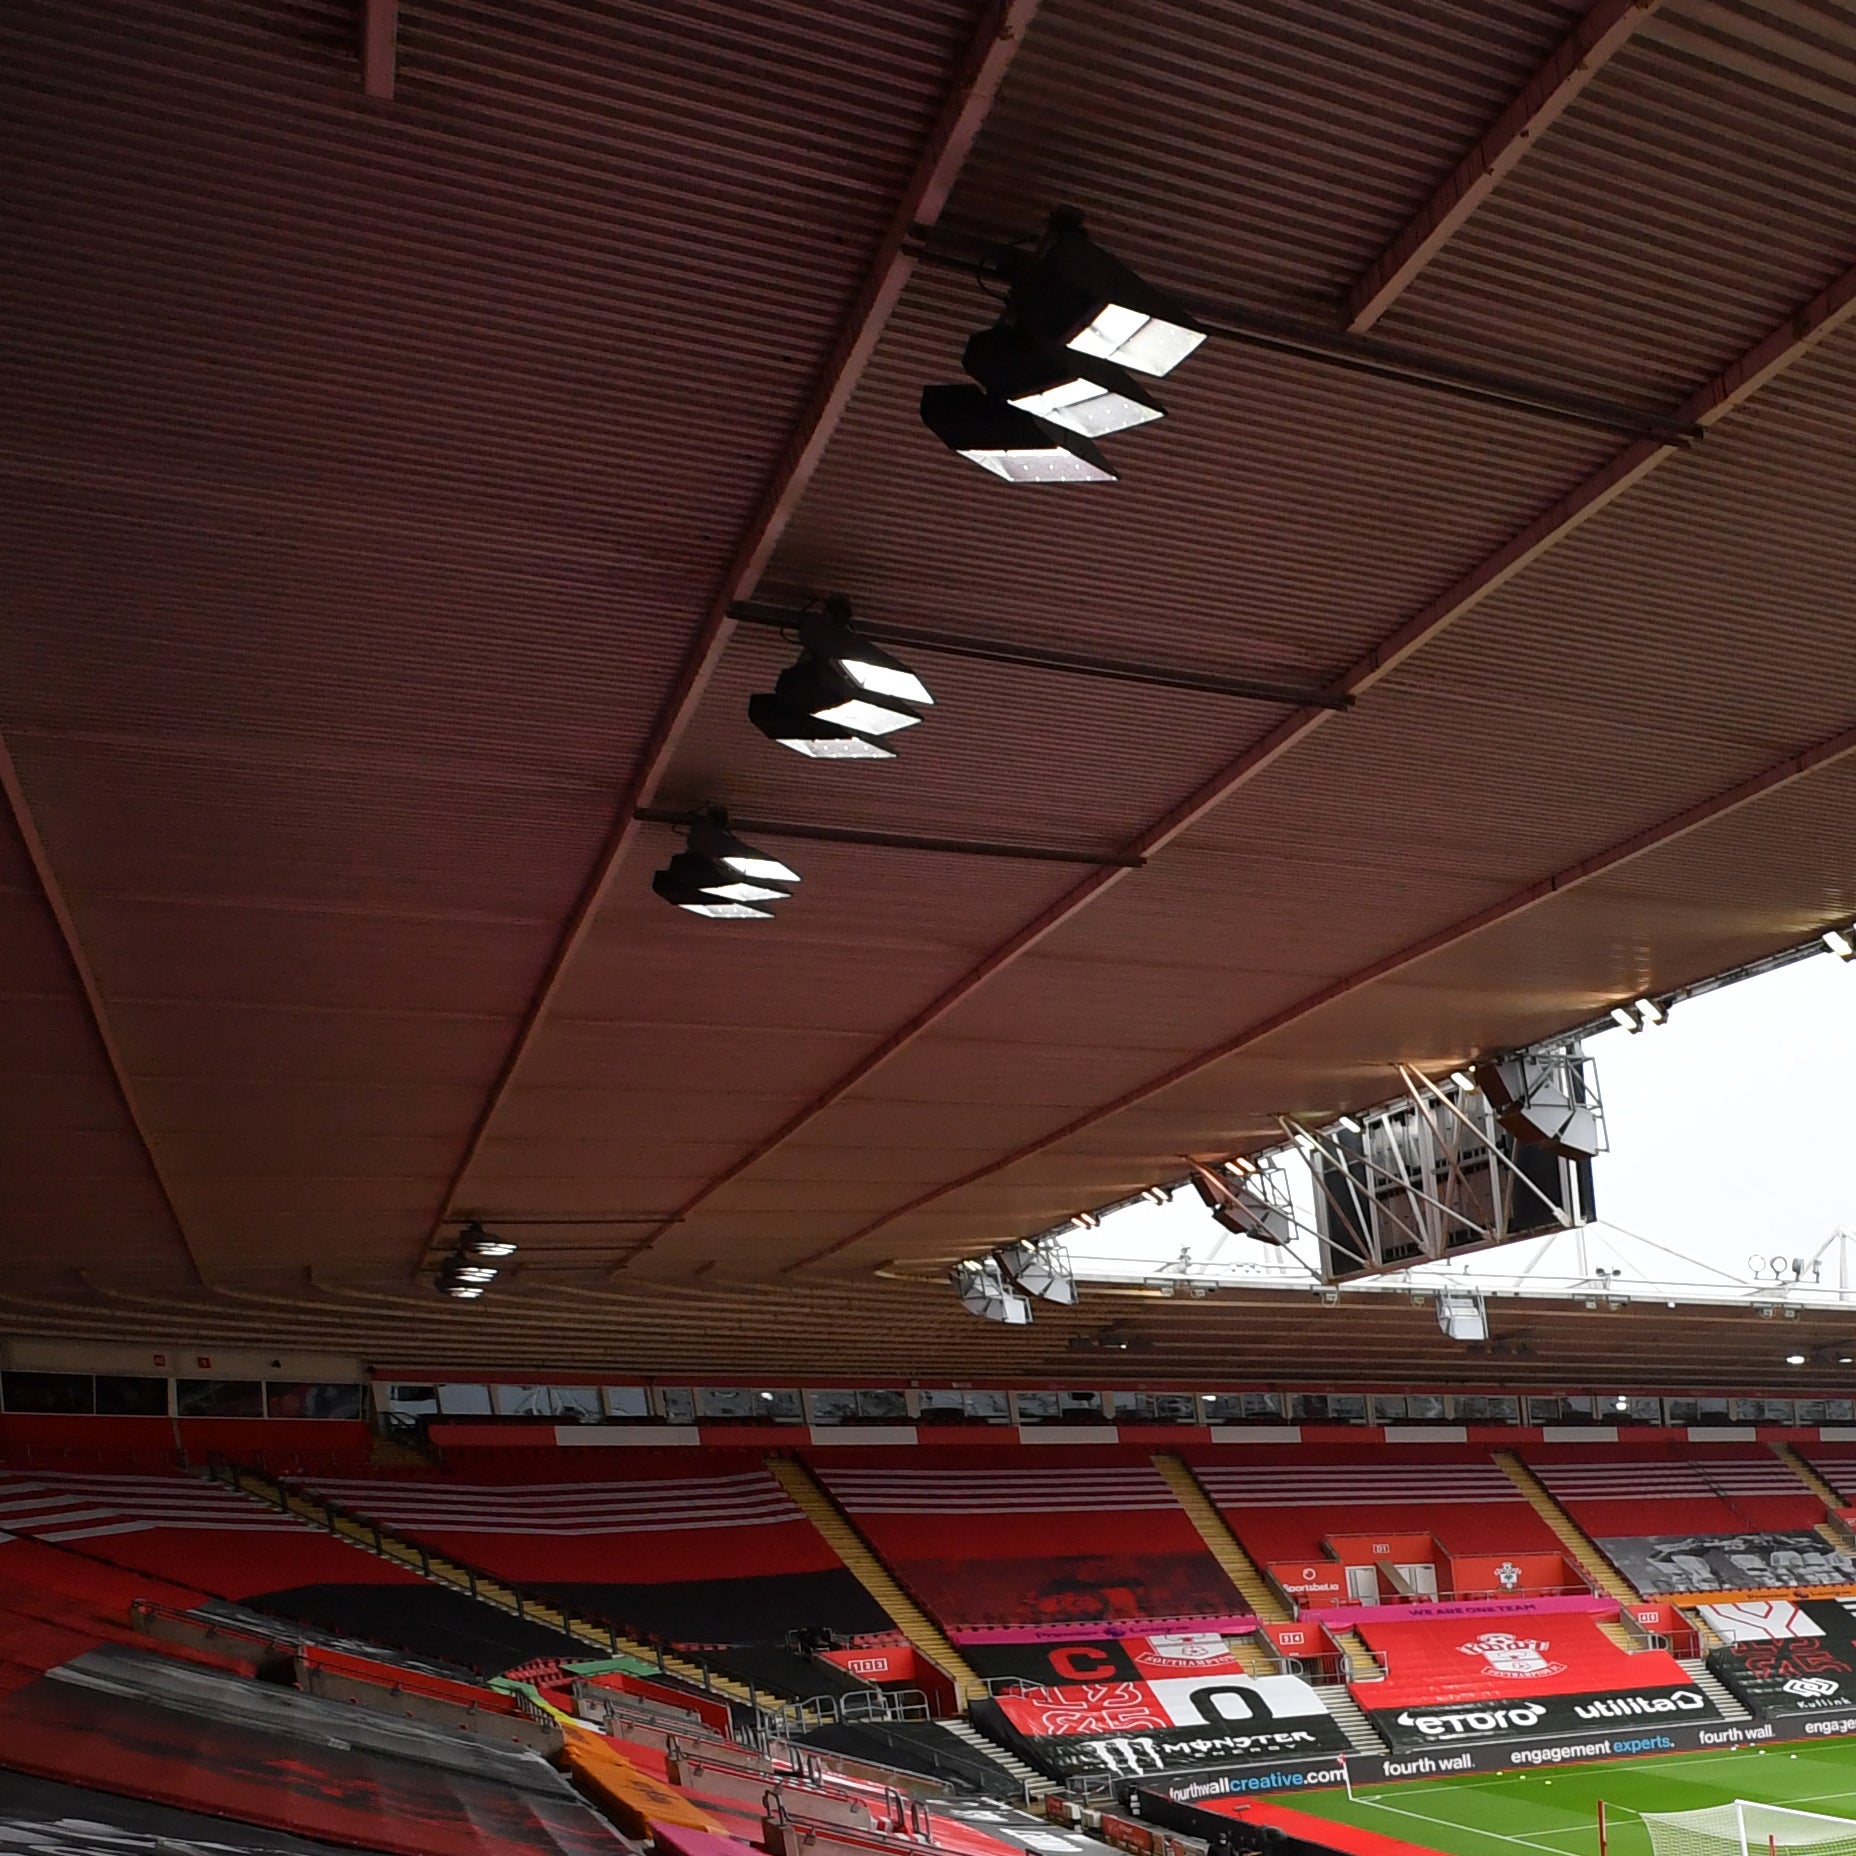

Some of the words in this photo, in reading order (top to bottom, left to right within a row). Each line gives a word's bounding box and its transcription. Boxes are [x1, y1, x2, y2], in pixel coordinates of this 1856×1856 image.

[1409, 1606, 1433, 1617] WE
[1435, 1606, 1465, 1616] ARE
[1466, 1604, 1494, 1615] ONE
[1495, 1603, 1537, 1613] TEAM
[1048, 1646, 1117, 1681] C
[1575, 1695, 1672, 1720] utilita
[1164, 1730, 1317, 1755] MONSTER
[1699, 1727, 1743, 1745] fourth
[1510, 1740, 1612, 1765] engagement
[1613, 1736, 1675, 1754] experts.
[1383, 1760, 1437, 1778] fourth
[1169, 1767, 1347, 1802] fourthwallcreative.com
